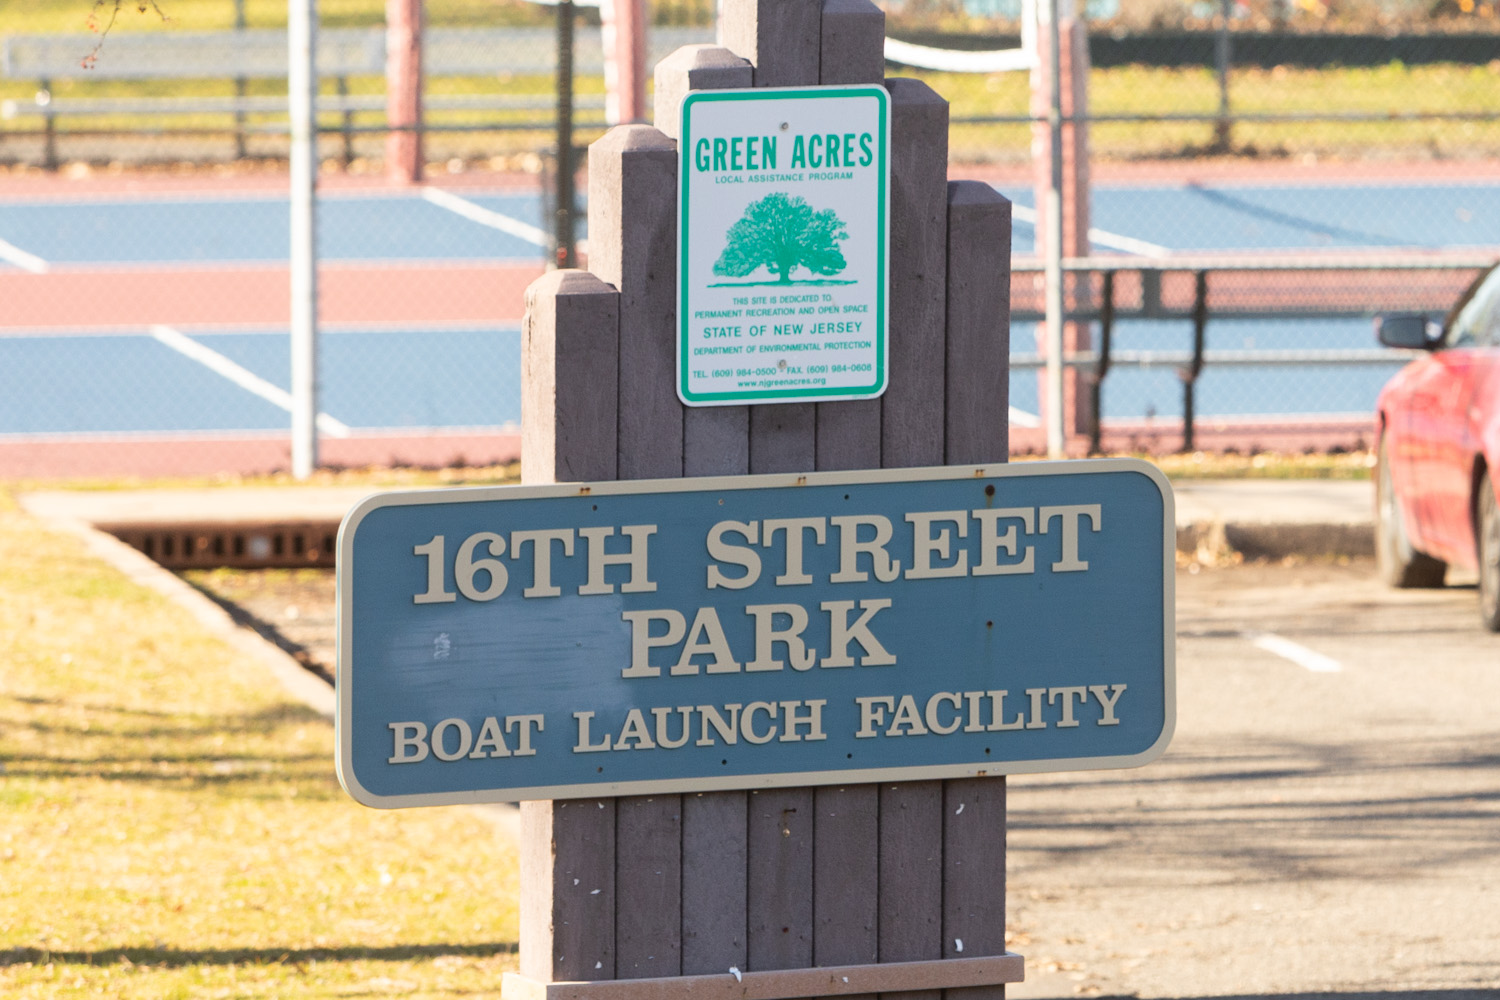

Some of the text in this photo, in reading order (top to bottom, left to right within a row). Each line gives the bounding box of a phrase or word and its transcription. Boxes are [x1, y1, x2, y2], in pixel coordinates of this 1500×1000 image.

[696, 132, 873, 172] GREEN ACRES
[715, 172, 853, 184] LOCAL ASSISTANCE PROGRAM
[733, 294, 831, 305] THIS SITE IS DEDICATED TO
[695, 310, 742, 319] PERMANENT
[746, 308, 795, 316] RECREATION
[818, 306, 839, 314] OPEN
[843, 305, 868, 313] SPACE
[704, 322, 862, 338] STATE OF NEW JERSEY
[694, 341, 871, 355] DEPARTMENT OF ENVIRONMENTAL PROTECTION
[712, 369, 733, 377] (609)
[736, 367, 776, 376] 984-0500
[807, 365, 828, 374] (609)
[738, 377, 826, 387] www.njgreenacres.org
[412, 504, 1102, 604] 16TH STREET
[622, 599, 897, 677] PARK
[389, 684, 1127, 764] BOAT LAUNCH FACILITY
